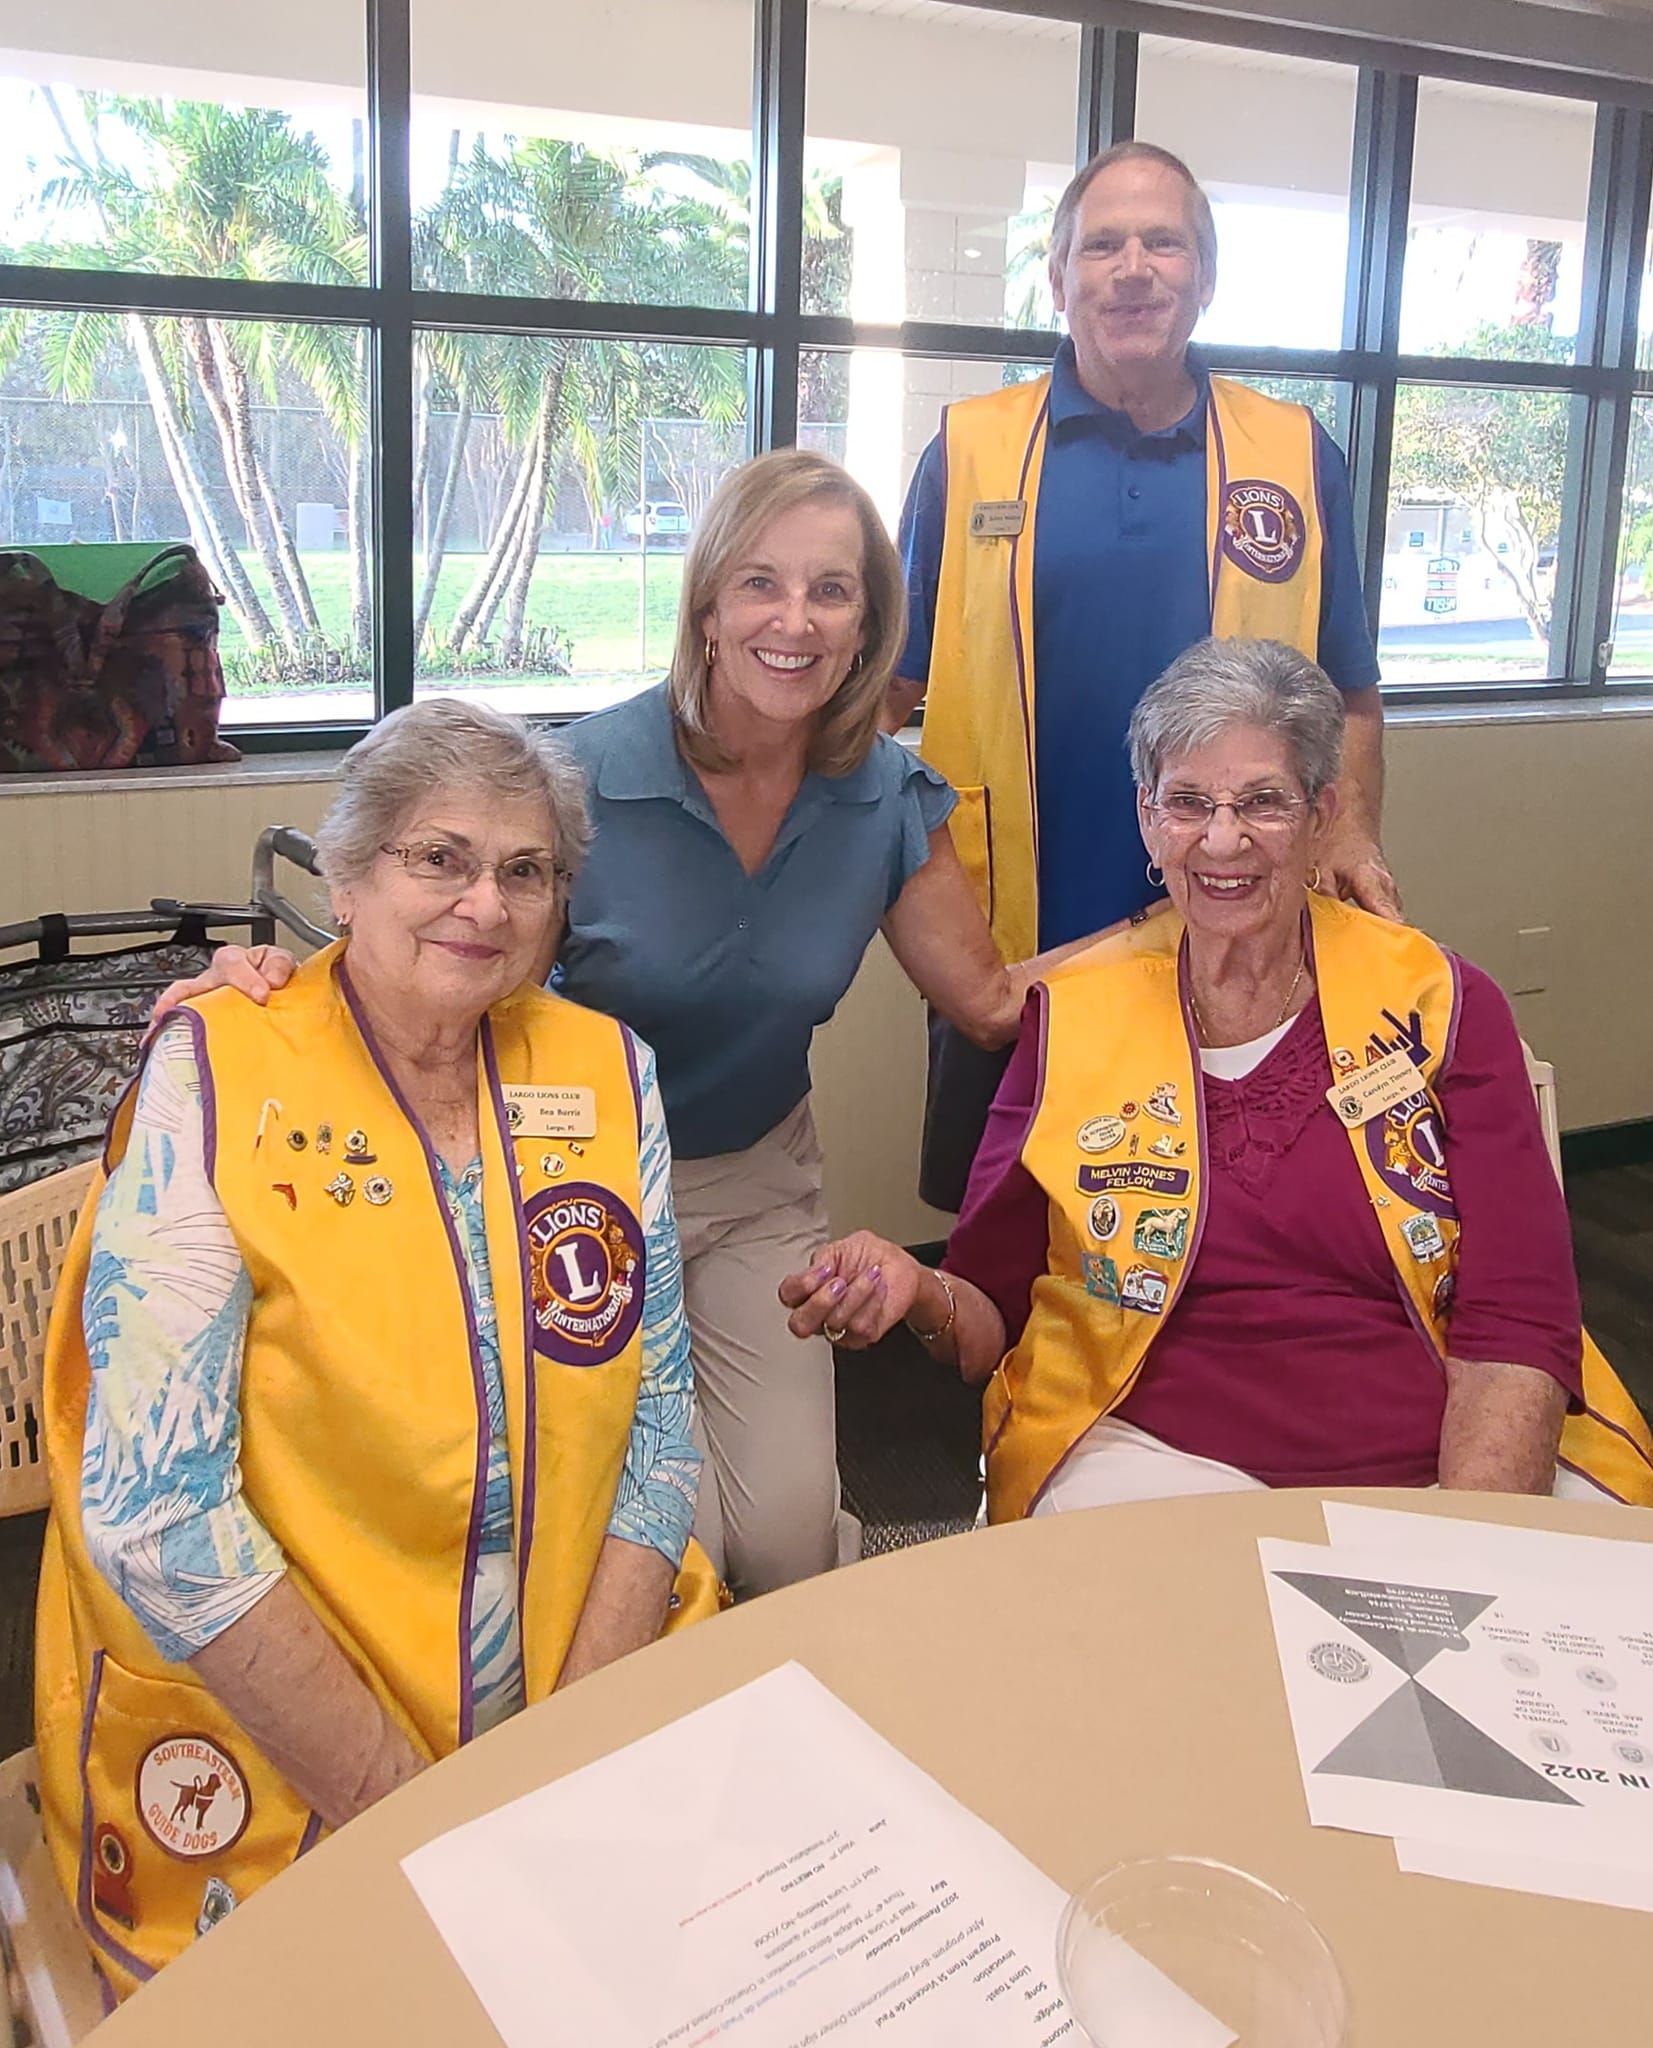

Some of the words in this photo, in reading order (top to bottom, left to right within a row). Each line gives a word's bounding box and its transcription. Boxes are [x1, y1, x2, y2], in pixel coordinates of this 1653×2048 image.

[1234, 489, 1280, 506] LIONS
[1247, 510, 1277, 543] L
[1379, 1058, 1396, 1070] CLUB
[1090, 1167, 1130, 1179] MELVIN
[1133, 1165, 1175, 1180] JONES
[1106, 1176, 1154, 1187] FELLOW
[532, 1204, 601, 1242] LIONS
[555, 1242, 601, 1301] L
[153, 1743, 240, 1802] SOUTHEASTERN
[1540, 1763, 1609, 1784] 2022
[1619, 1773, 1650, 1789] IN
[147, 1803, 180, 1843] GUIDE
[182, 1831, 217, 1849] DOGS
[812, 1862, 824, 1872] NO
[780, 1870, 812, 1892] MEETING
[929, 1879, 947, 1893] May
[940, 1892, 959, 1908] 2023
[899, 1904, 941, 1935] Remaining
[965, 1917, 984, 1936] After
[864, 1933, 900, 1960] Calendar
[965, 1932, 1000, 1961] Program
[946, 1958, 967, 1975] from
[1009, 1965, 1031, 1984] Lions
[936, 1972, 948, 1982] St
[905, 1978, 938, 2005] Vincent
[894, 2000, 906, 2012] de
[874, 2009, 895, 2027] Paul
